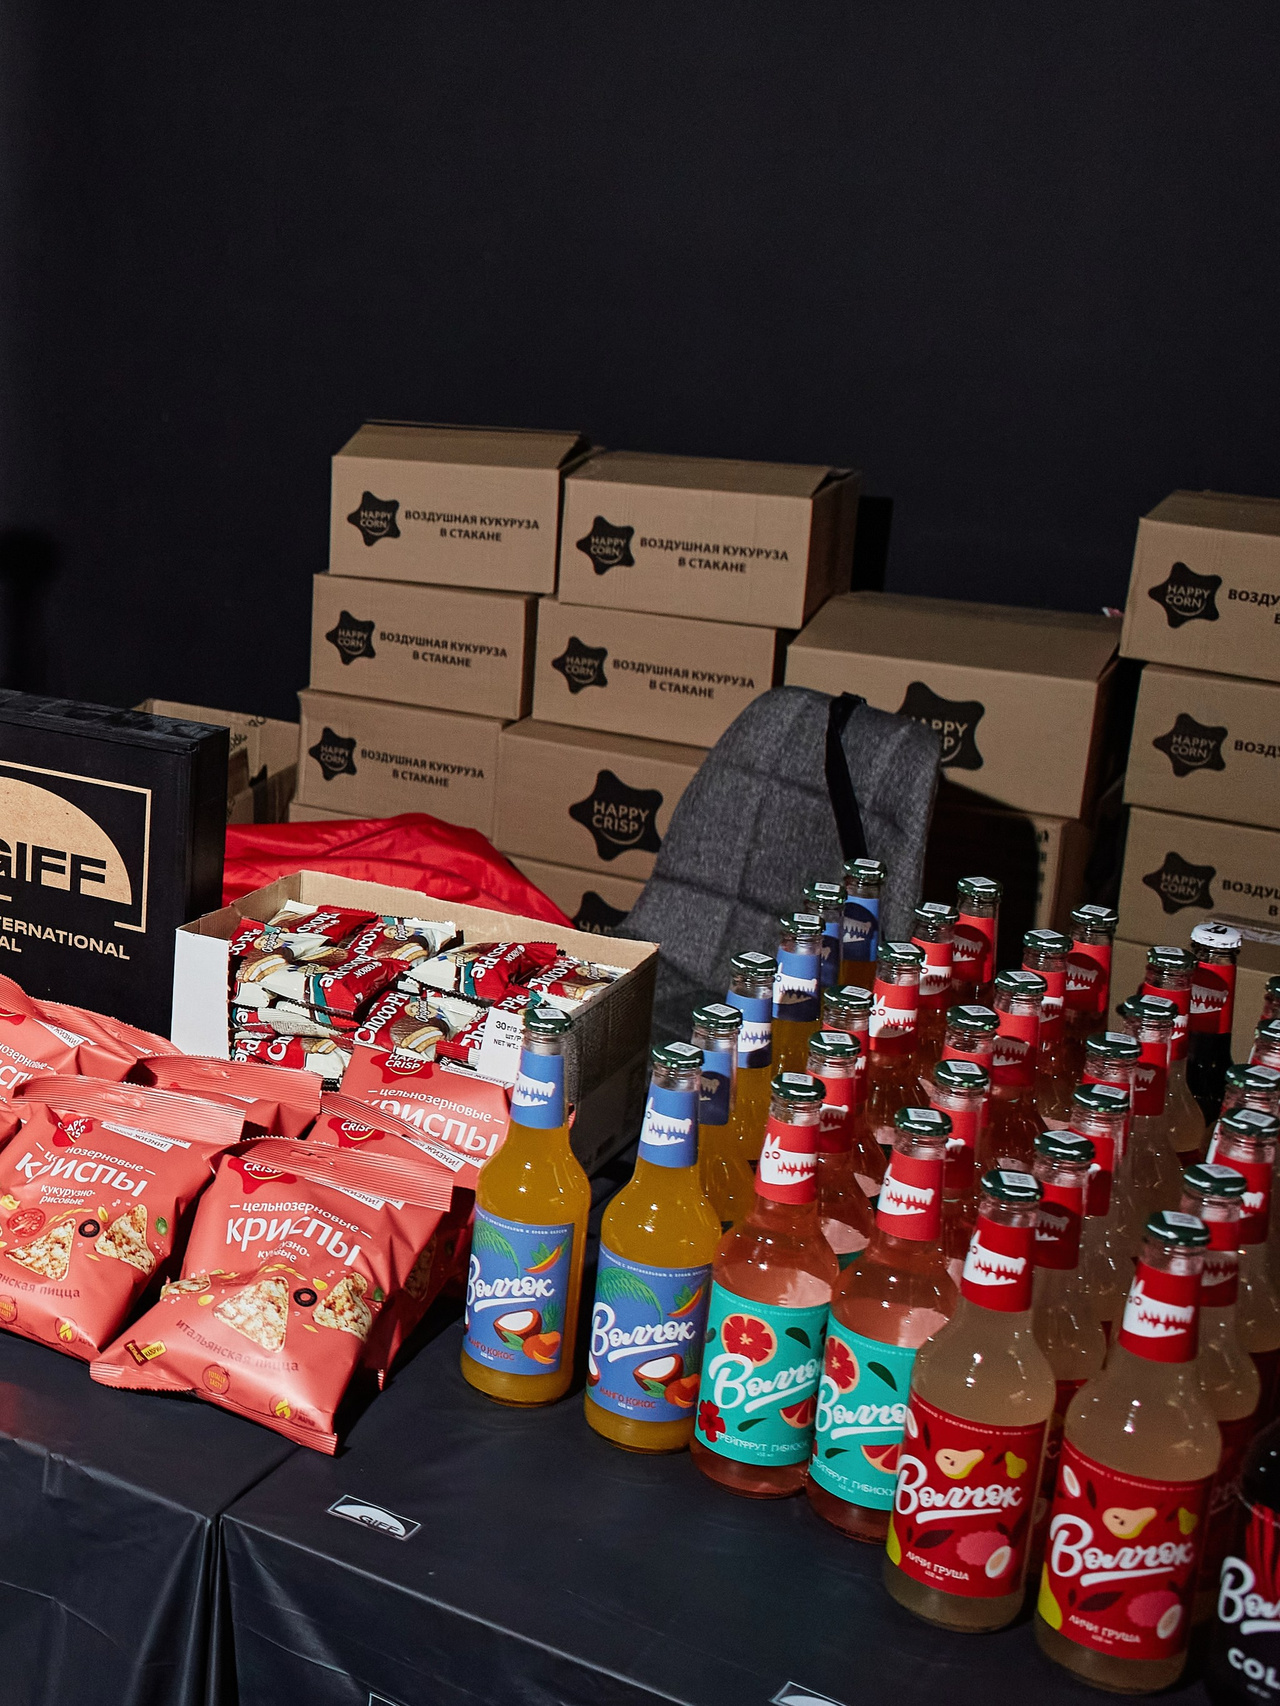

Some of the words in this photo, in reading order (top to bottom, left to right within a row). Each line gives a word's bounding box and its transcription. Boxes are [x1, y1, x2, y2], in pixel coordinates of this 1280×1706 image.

[405, 510, 477, 525] ВОЗДУШНАЯ
[479, 516, 539, 530] КУКУРУЗА
[440, 528, 447, 537] В
[449, 529, 502, 542] СТАКАНЕ
[640, 537, 720, 554] ВОЗДУШНАЯ
[723, 545, 789, 560] КУКУРУЗА
[678, 557, 686, 567] В
[689, 558, 746, 573] СТАКАНЕ
[1167, 584, 1211, 599] HAPPY
[1165, 595, 1201, 608] CORN
[380, 631, 448, 649] ВОЗДУШНАЯ
[450, 641, 507, 657] КУКУРУЗА
[412, 651, 419, 660] В
[422, 652, 471, 667] СТАКАНЕ
[613, 659, 689, 678] ВОЗДУШНАЯ
[691, 671, 755, 689] КУКУРУЗА
[649, 680, 657, 690] В
[659, 682, 714, 698] СТАКАНЕ
[1171, 744, 1207, 758] CORN
[1172, 735, 1217, 749] HAPPY
[1234, 739, 1280, 758] ВОЗД
[361, 749, 426, 769] ВОЗДУШНАЯ
[429, 761, 484, 779] КУКУРУЗА
[392, 769, 399, 778] В
[401, 771, 449, 787] СТАКАНЕ
[593, 801, 649, 822] HAPPY
[592, 815, 639, 833] CRISP
[1160, 882, 1196, 896] CORN
[1162, 872, 1206, 888] HAPPY
[385, 1060, 421, 1070] CRISP
[380, 1089, 492, 1122] цельнозерновые
[133, 1133, 169, 1149] ЖИЗНИ!
[39, 1194, 84, 1206] рисовые
[243, 1202, 360, 1233] цельнозерновые
[226, 1216, 361, 1267] криспы
[39, 1286, 81, 1299] пицца
[176, 1319, 252, 1364] итальянская
[487, 1347, 515, 1360] КОКОС
[708, 1352, 820, 1409] Волчо
[626, 1397, 656, 1409] КОКОС
[816, 1375, 908, 1432] Волчо
[359, 1515, 401, 1536] GIFF
[906, 1551, 931, 1569] ЛИЧИ
[933, 1563, 970, 1581] ГРУША
[1101, 1626, 1141, 1643] ГРУША
